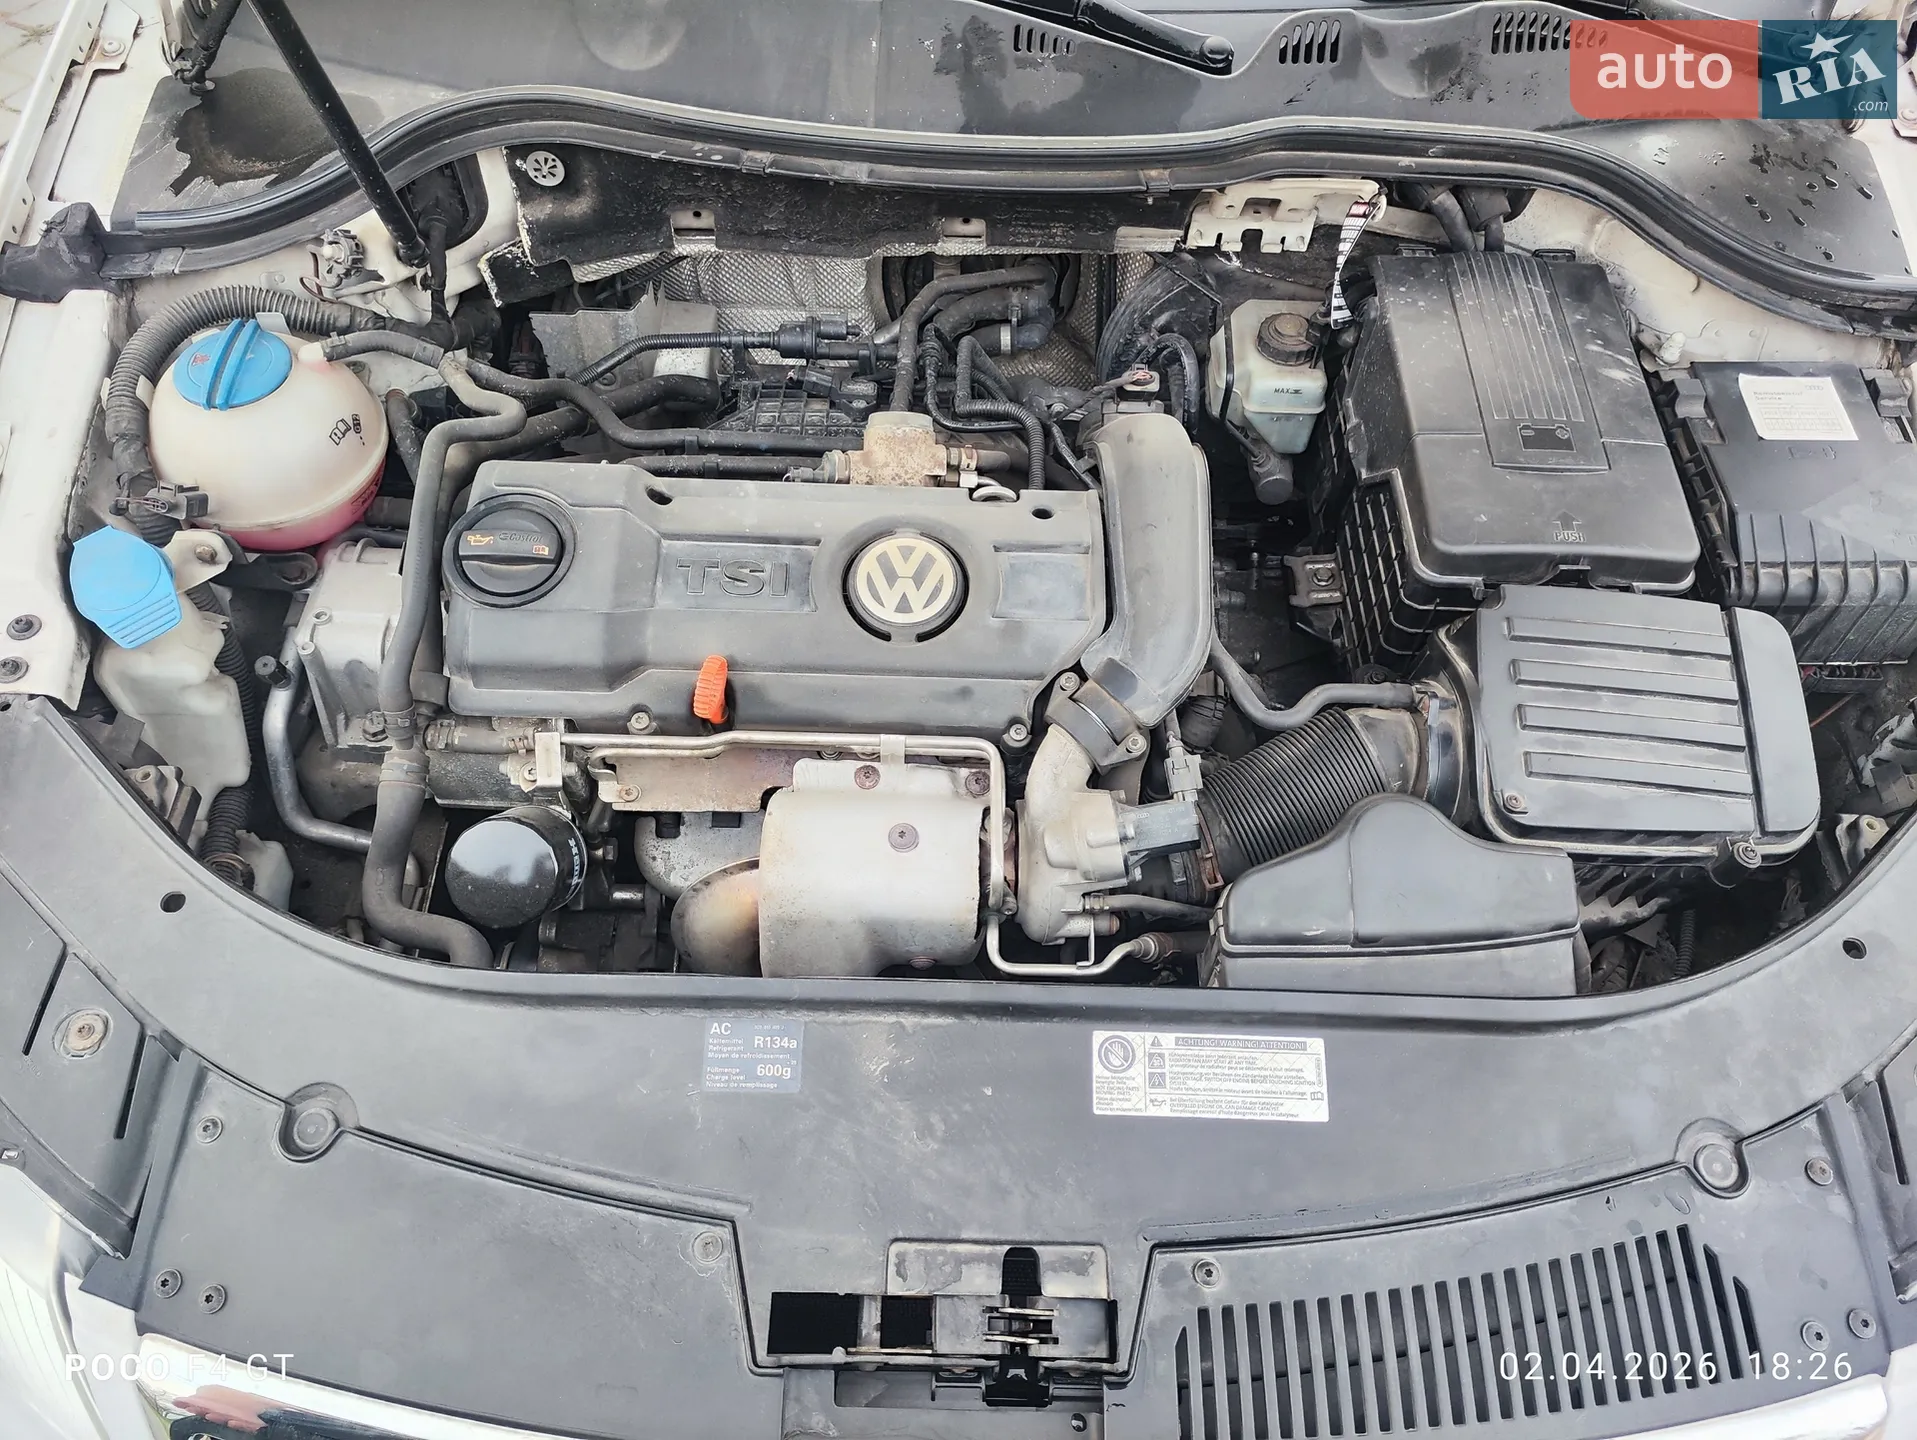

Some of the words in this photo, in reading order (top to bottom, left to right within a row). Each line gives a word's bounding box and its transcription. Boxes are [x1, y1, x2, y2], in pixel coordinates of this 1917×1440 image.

[509, 532, 543, 543] Castrol
[1554, 531, 1586, 542] PUSH
[677, 558, 790, 597] TSI
[710, 1022, 731, 1034] AC
[754, 1036, 797, 1048] R134a
[1178, 1038, 1218, 1046] ACHTUNG!
[1219, 1040, 1258, 1048] WARNING!
[1260, 1041, 1304, 1049] ATTENTION!
[757, 1064, 791, 1079] 600g
